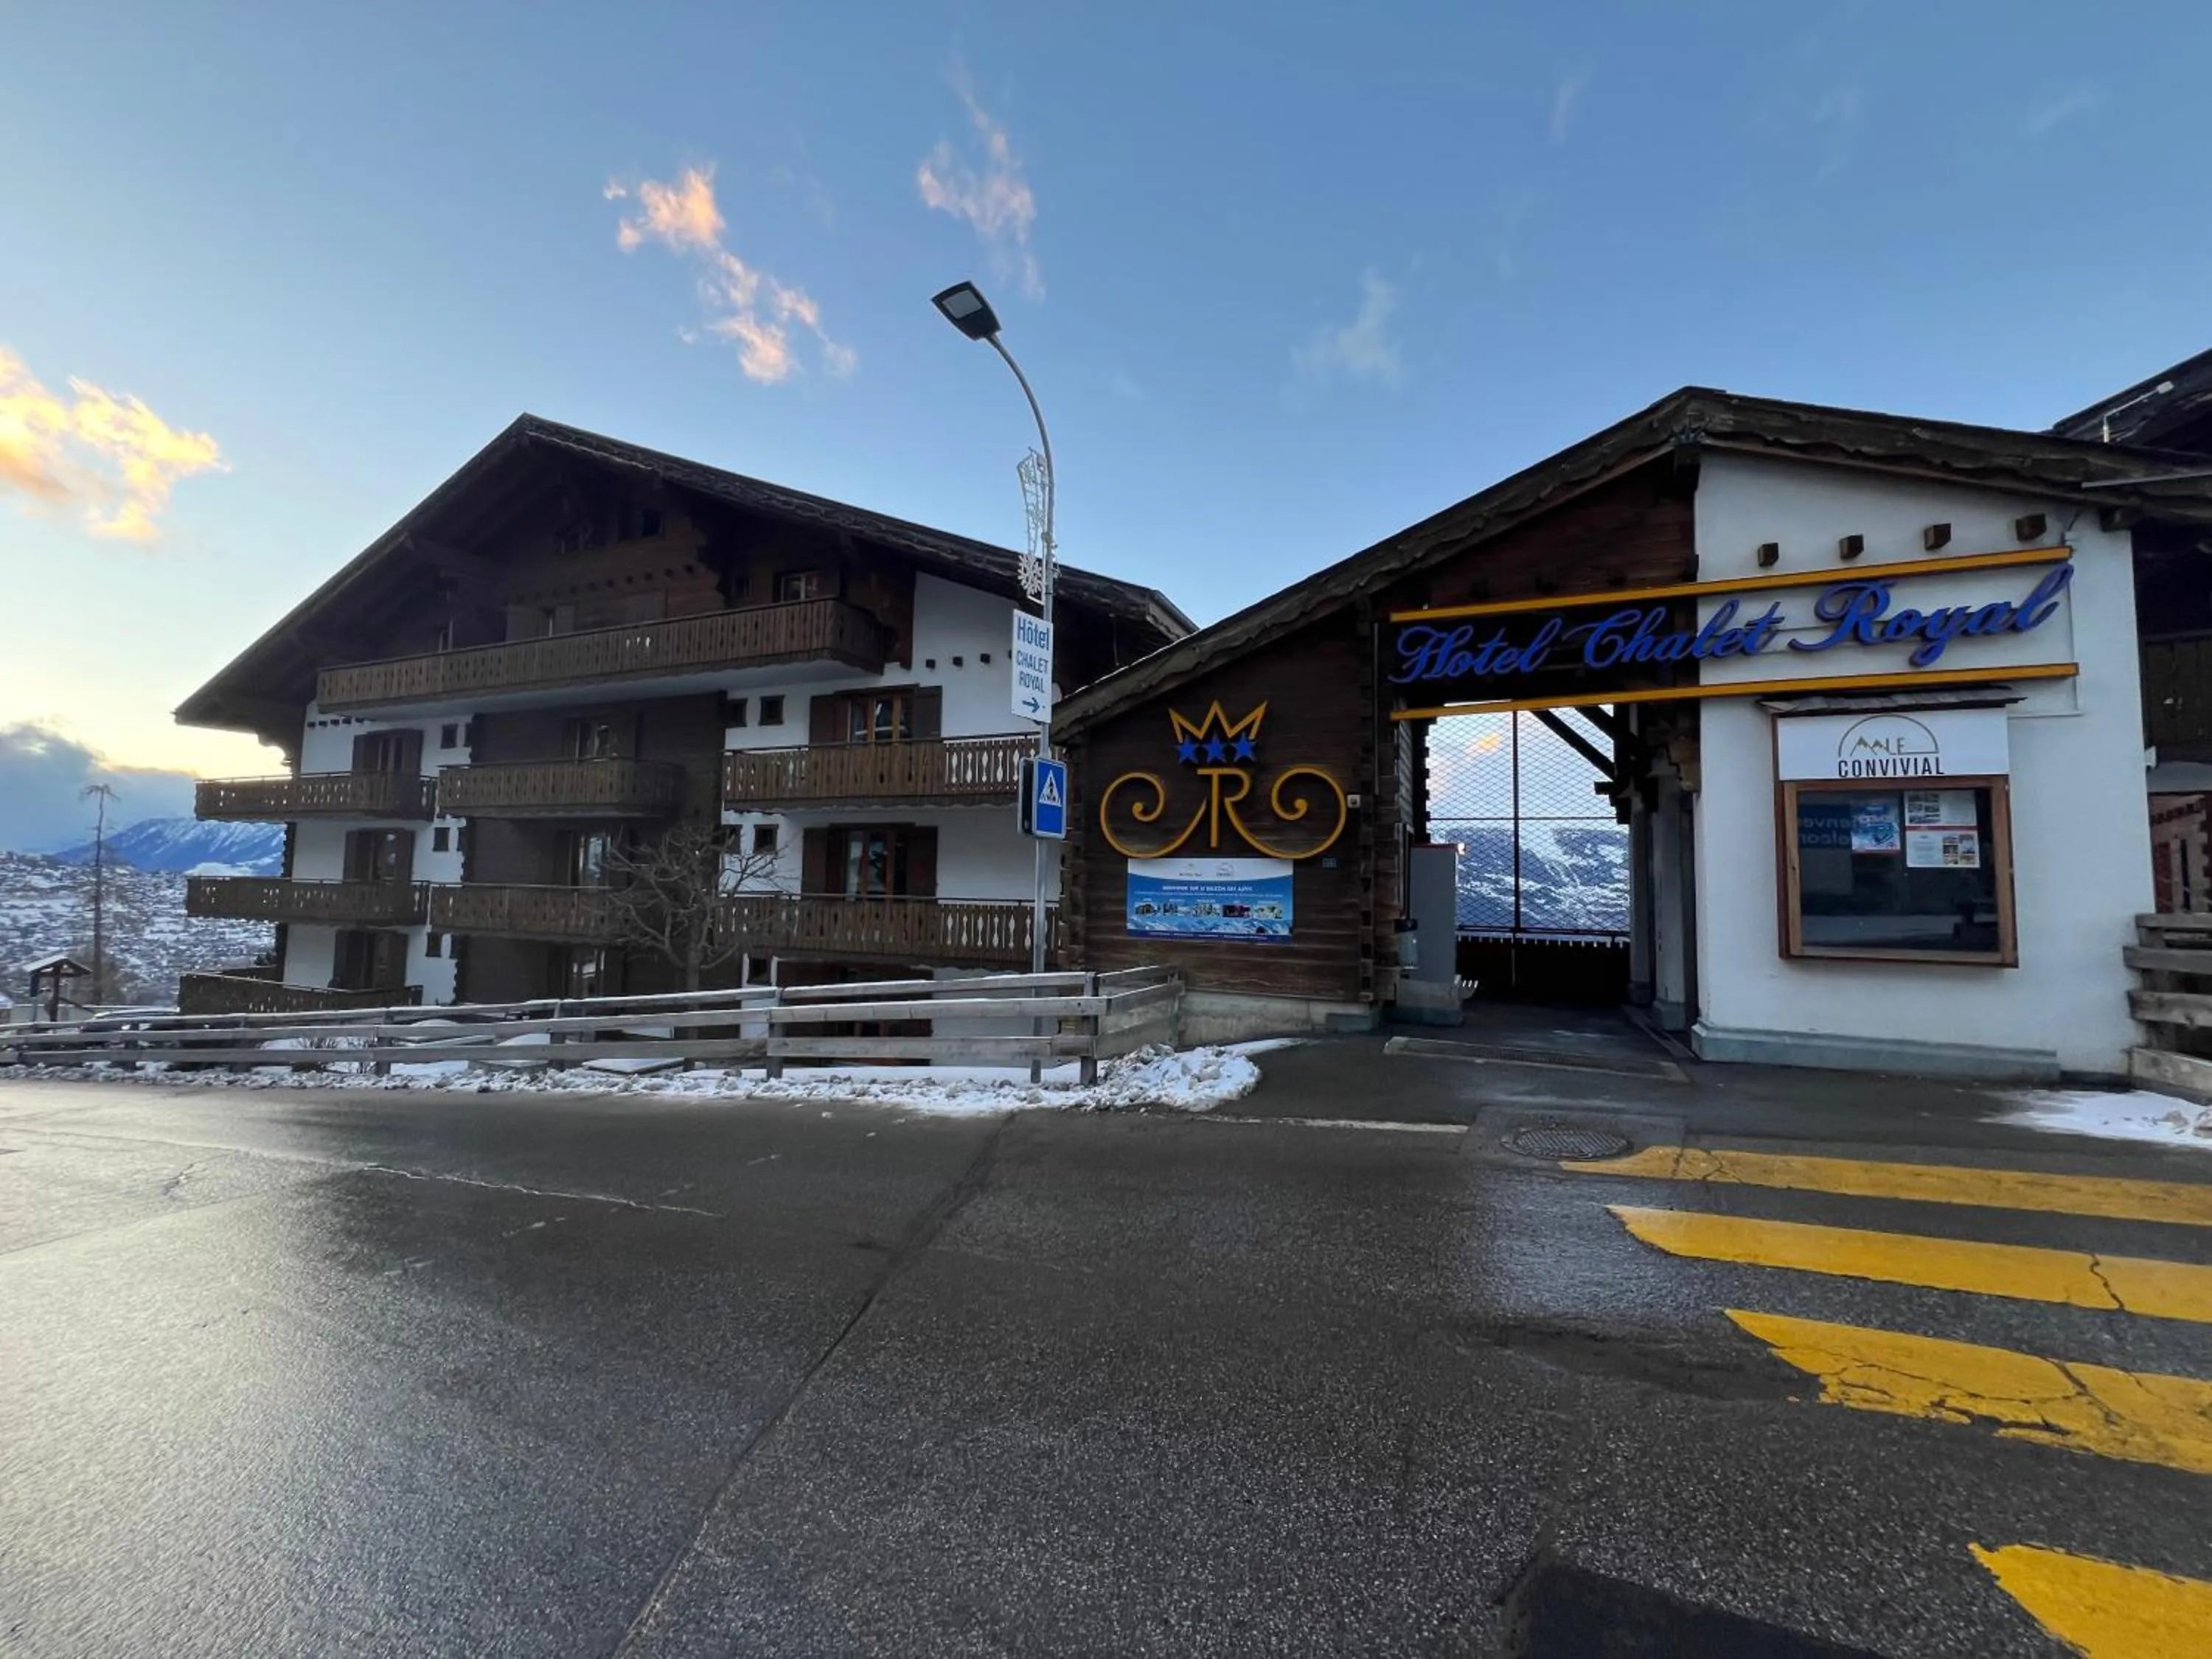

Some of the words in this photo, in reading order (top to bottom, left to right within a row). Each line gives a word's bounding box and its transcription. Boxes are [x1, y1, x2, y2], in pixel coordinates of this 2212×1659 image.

[1017, 616, 1049, 650] Hôtel
[1388, 617, 1562, 684] Hotel
[1562, 599, 1785, 669] Chalet
[1788, 563, 2074, 668] Royal
[1016, 650, 1049, 674] CHALET
[1019, 669, 1045, 694] ROYAL
[1838, 756, 1945, 778] CONVIVIAL
